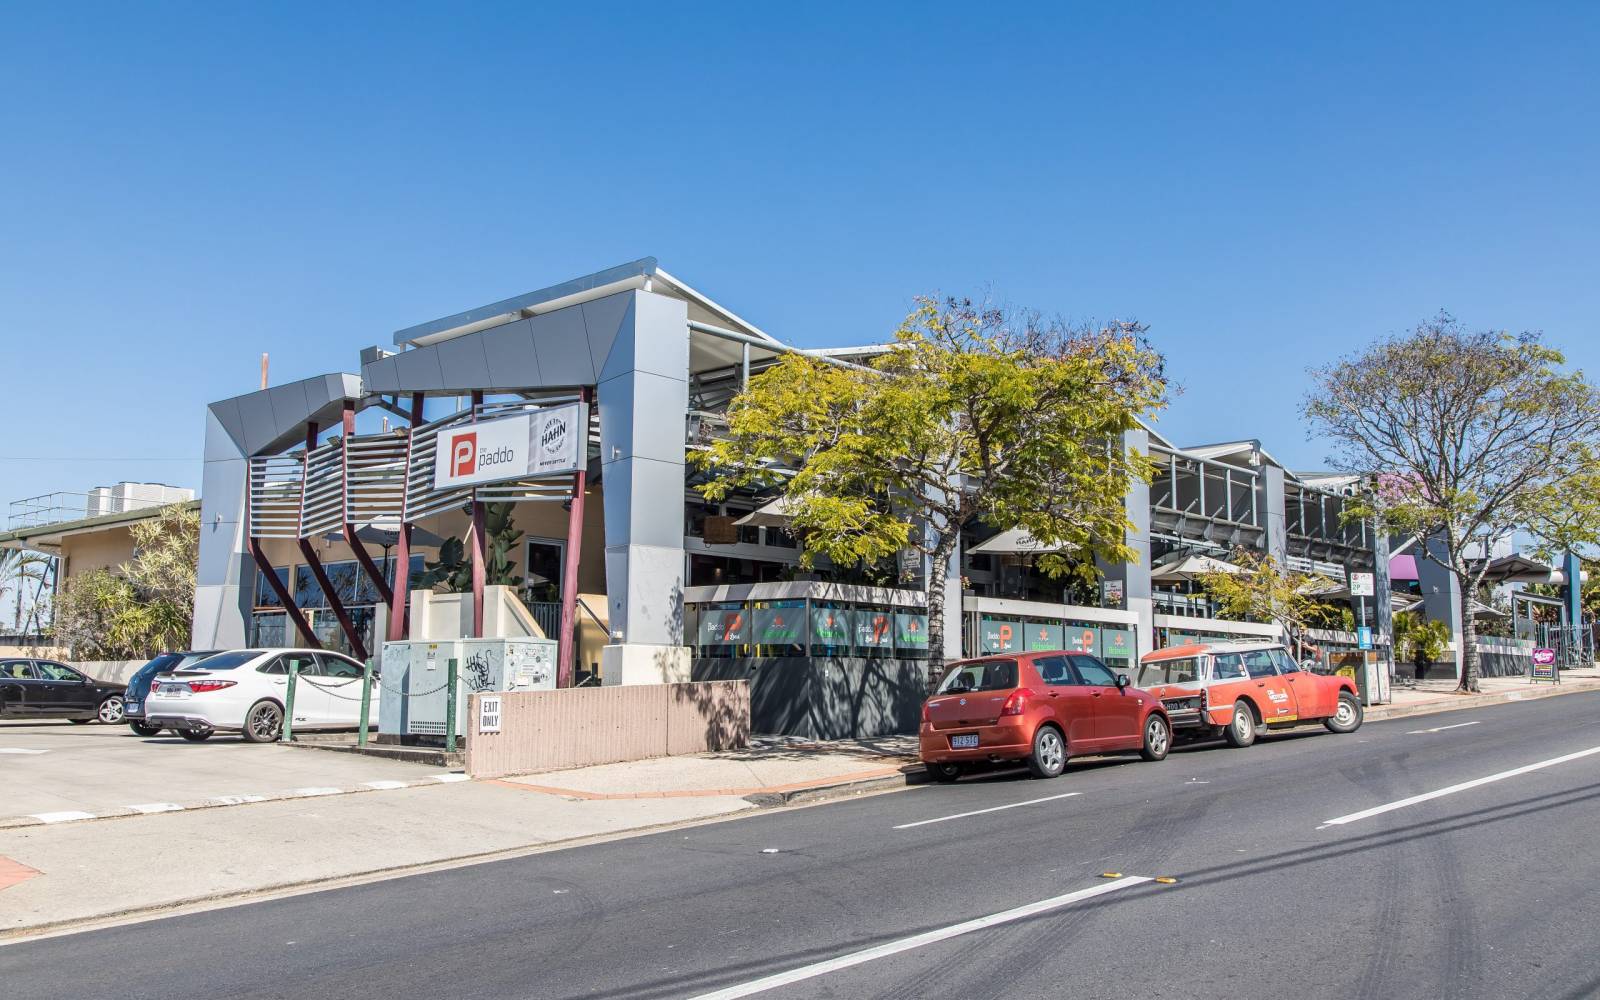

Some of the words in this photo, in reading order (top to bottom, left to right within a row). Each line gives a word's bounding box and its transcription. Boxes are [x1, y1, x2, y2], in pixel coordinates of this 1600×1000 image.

[541, 421, 566, 447] HAHN
[478, 445, 514, 471] paddo
[484, 701, 498, 713] EXIT
[482, 715, 498, 727] ONLY
